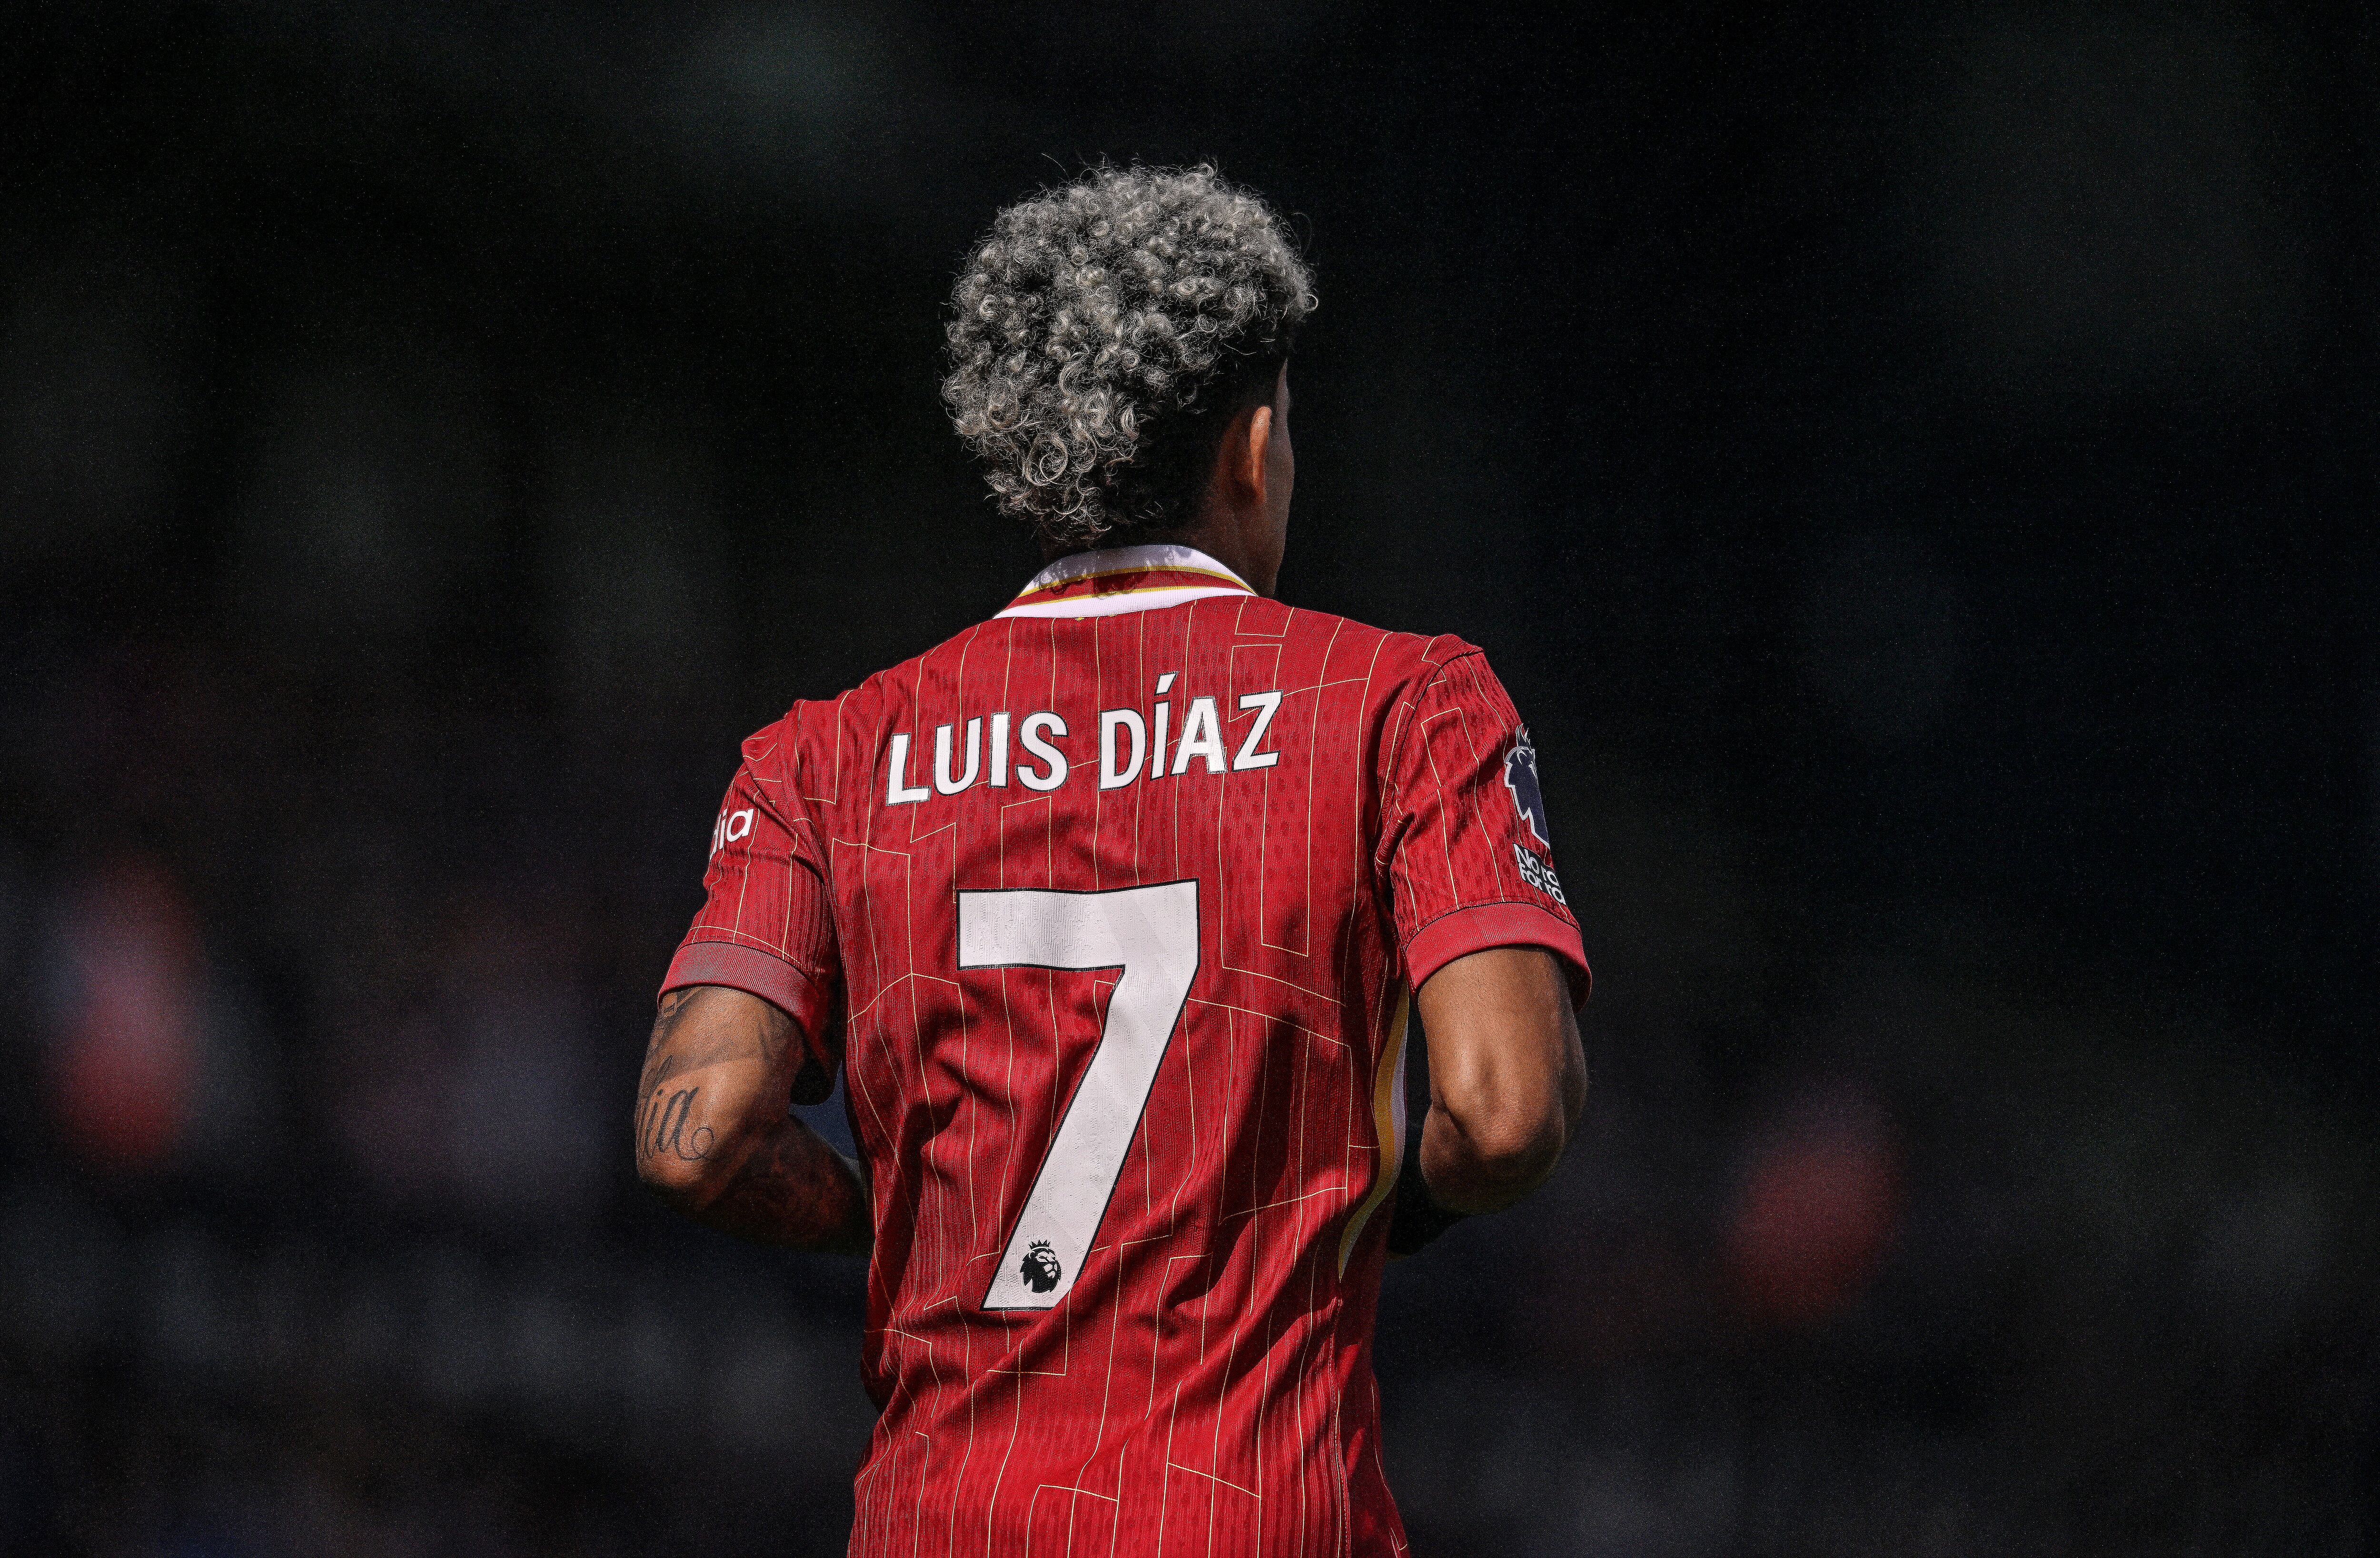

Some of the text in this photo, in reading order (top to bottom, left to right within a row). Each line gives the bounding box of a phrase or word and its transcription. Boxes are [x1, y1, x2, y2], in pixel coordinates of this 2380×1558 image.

[886, 670, 1283, 805] LUIS DÍAZ
[1513, 844, 1559, 886] No ro
[956, 878, 1200, 1310] 7
